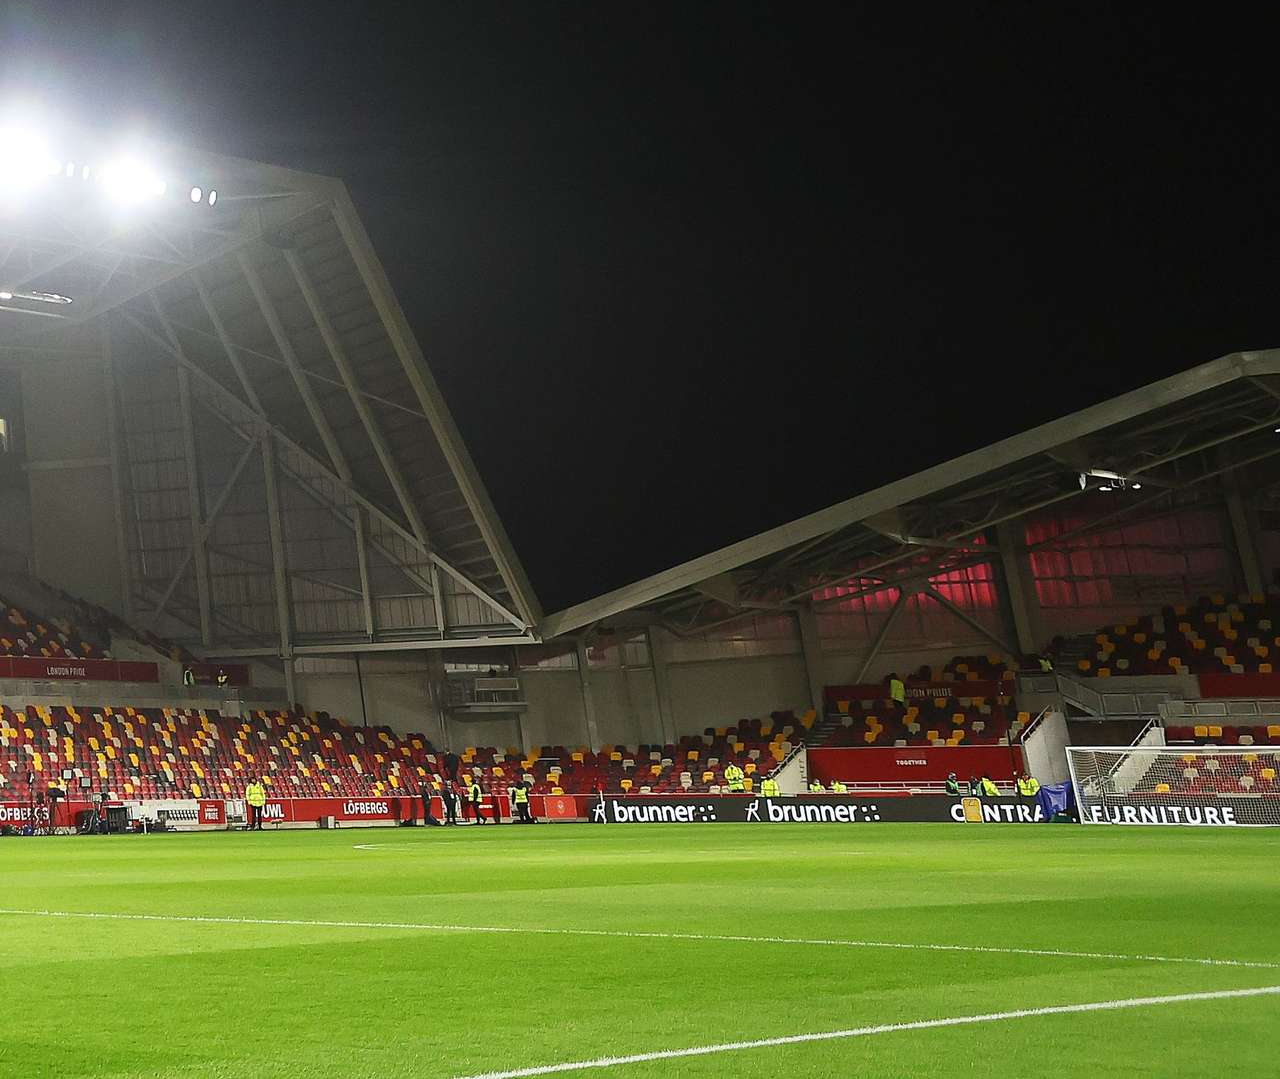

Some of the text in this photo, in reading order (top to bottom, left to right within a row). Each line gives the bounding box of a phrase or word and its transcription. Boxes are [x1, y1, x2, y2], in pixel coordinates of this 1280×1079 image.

[343, 800, 389, 815] LÖFBERGS
[612, 799, 696, 822] brunner
[766, 799, 858, 822] brunner
[1090, 805, 1237, 825] FURNITURE
